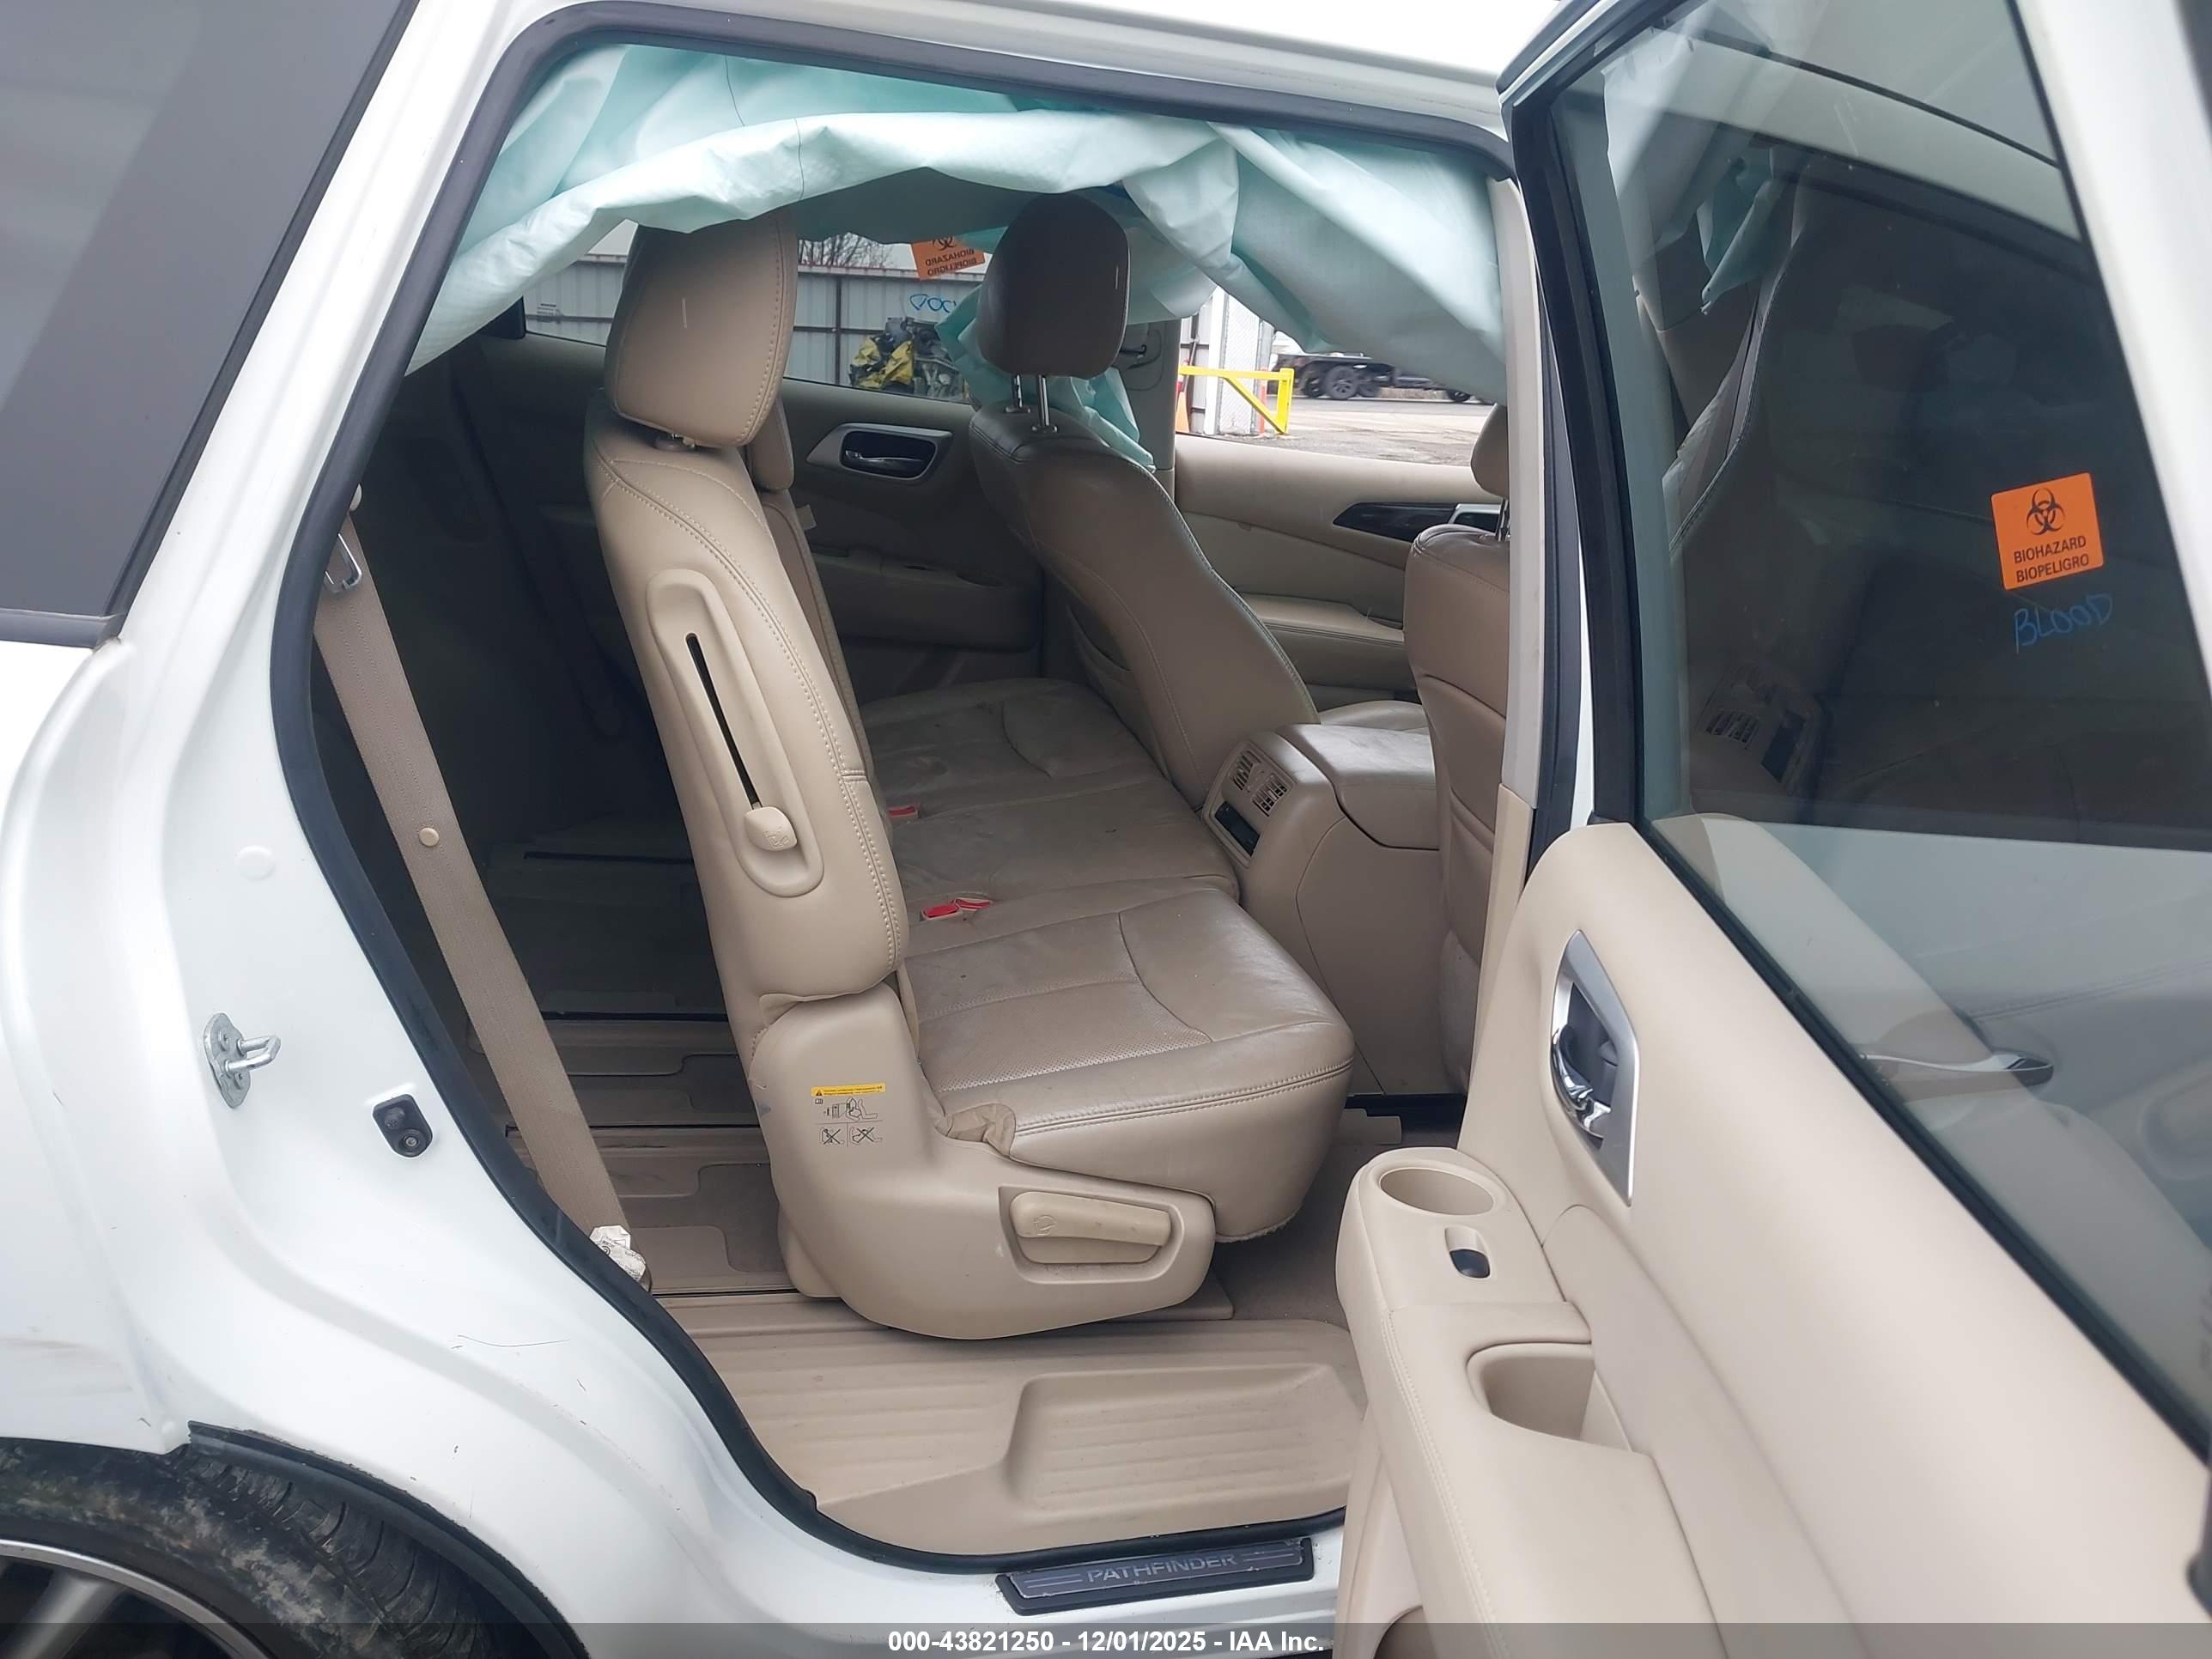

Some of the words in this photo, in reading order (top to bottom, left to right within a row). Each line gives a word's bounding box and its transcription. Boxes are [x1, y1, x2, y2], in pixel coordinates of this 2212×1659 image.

[2014, 535, 2087, 564] BIOHAZARD
[2016, 553, 2089, 583] BIOPELIGRO
[2014, 592, 2112, 654] BLOOD
[1086, 1553, 1237, 1583] PATHFINDER
